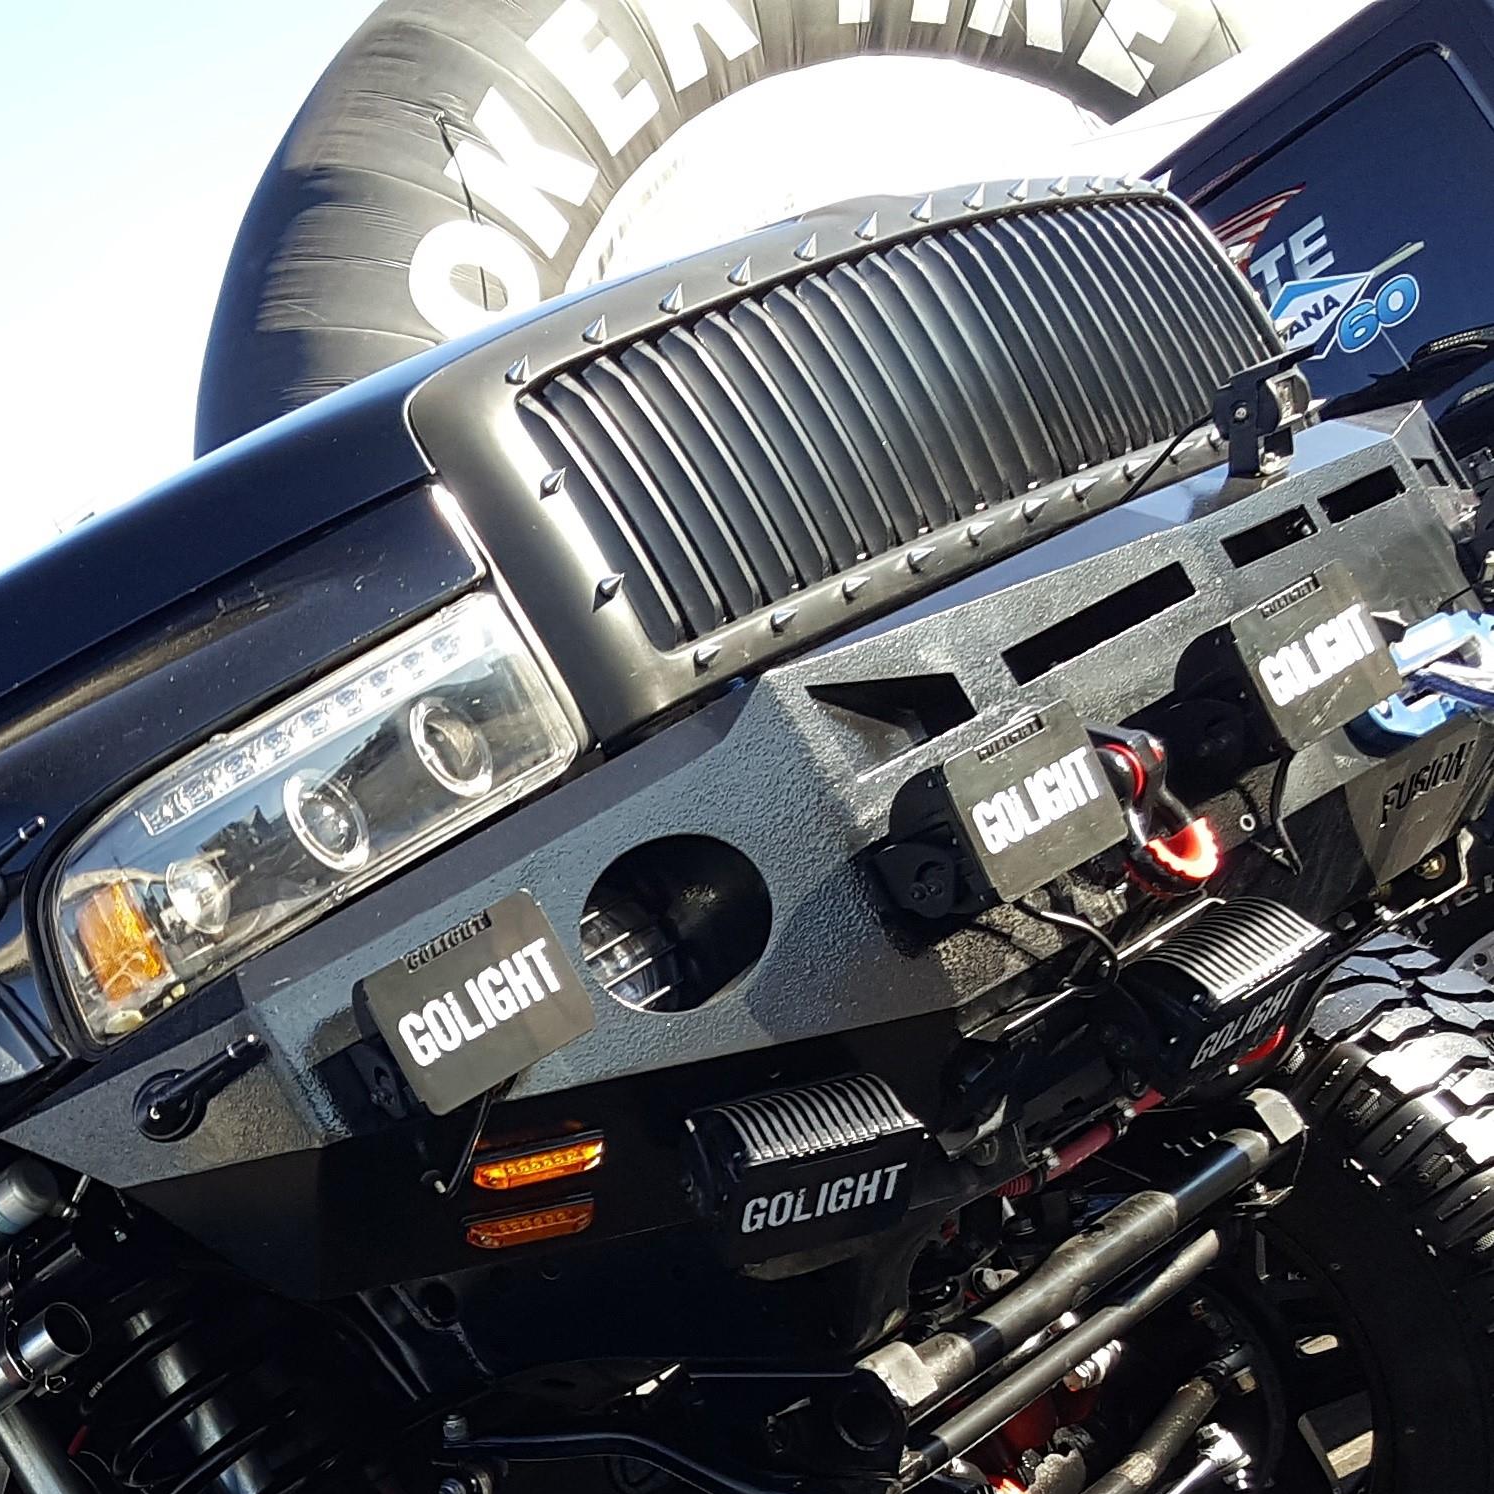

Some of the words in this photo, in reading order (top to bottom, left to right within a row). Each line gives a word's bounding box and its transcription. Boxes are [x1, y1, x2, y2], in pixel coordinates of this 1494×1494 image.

[1338, 274, 1420, 353] 60
[1258, 603, 1376, 707] GOLIGHT
[971, 745, 1100, 855] GOLIGHT
[1380, 739, 1476, 825] FUSION
[398, 937, 561, 1067] GOLIGHT
[1190, 971, 1308, 1070] GOLIGHT
[740, 1161, 908, 1234] GOLIGHT
